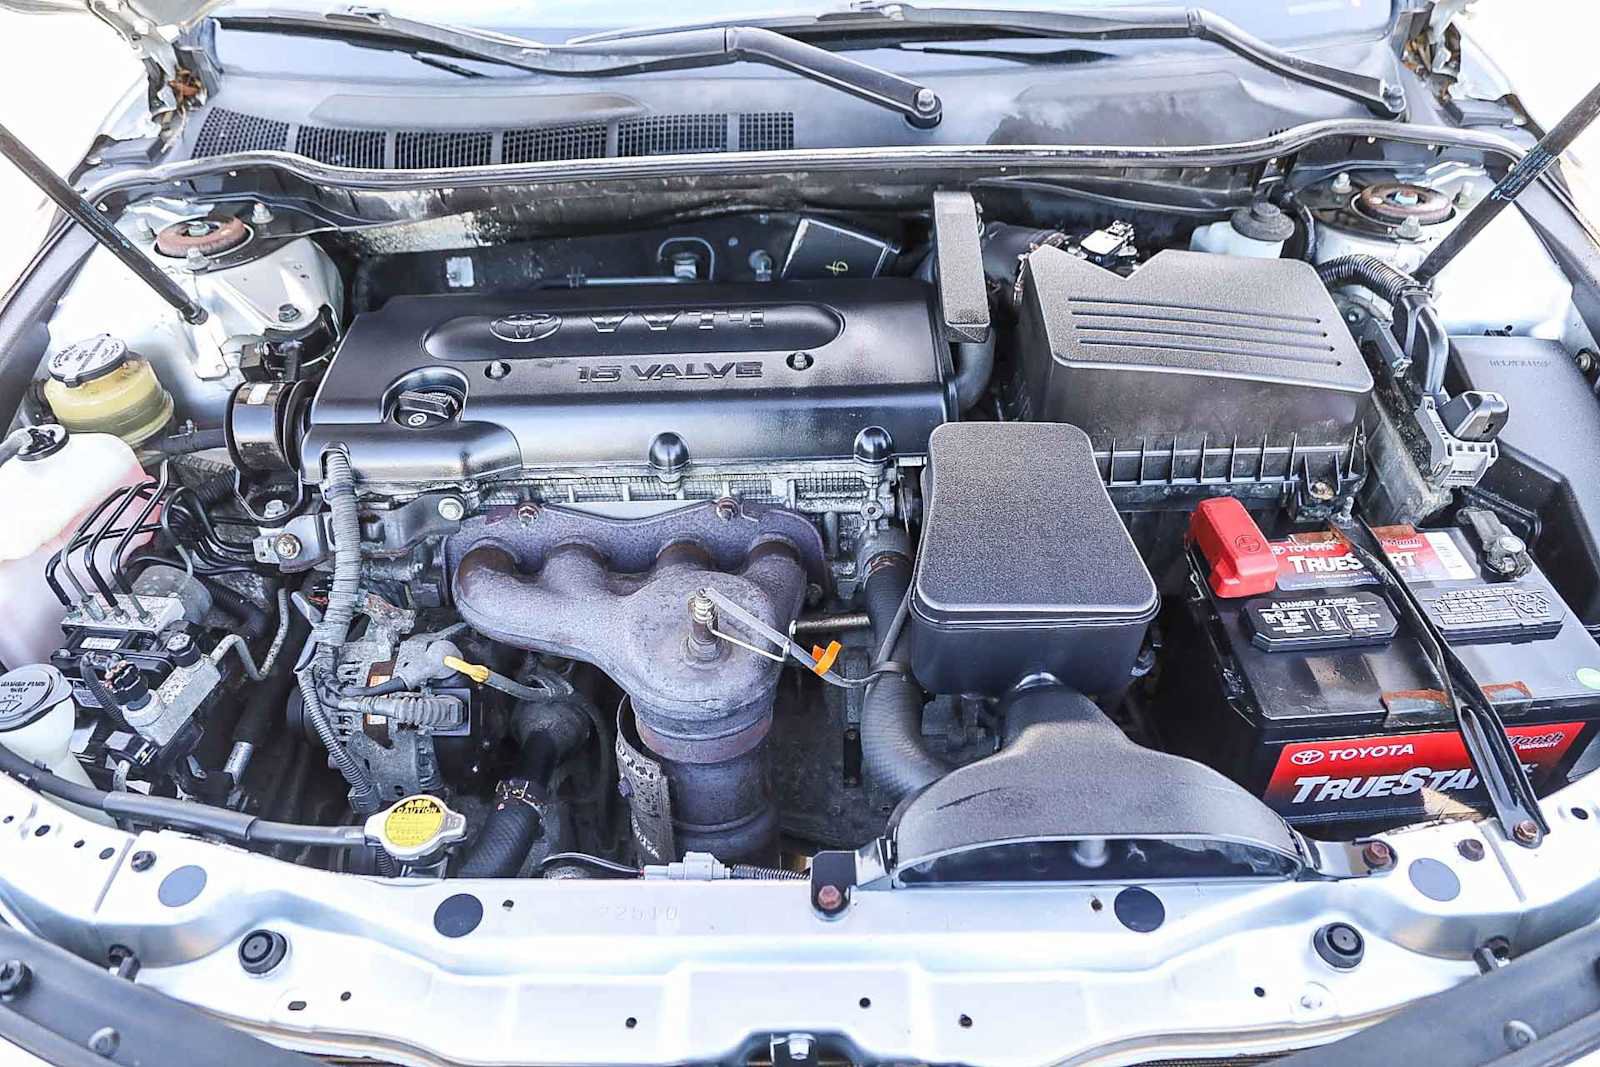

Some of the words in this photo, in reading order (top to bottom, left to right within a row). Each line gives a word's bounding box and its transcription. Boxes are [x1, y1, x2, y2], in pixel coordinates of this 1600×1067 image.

[578, 365, 622, 383] 16
[630, 361, 763, 381] VALVE
[1287, 543, 1335, 553] TOYOTA
[1280, 600, 1317, 609] DANGER
[1329, 744, 1414, 761] TOYOTA
[396, 806, 439, 814] CAUTION
